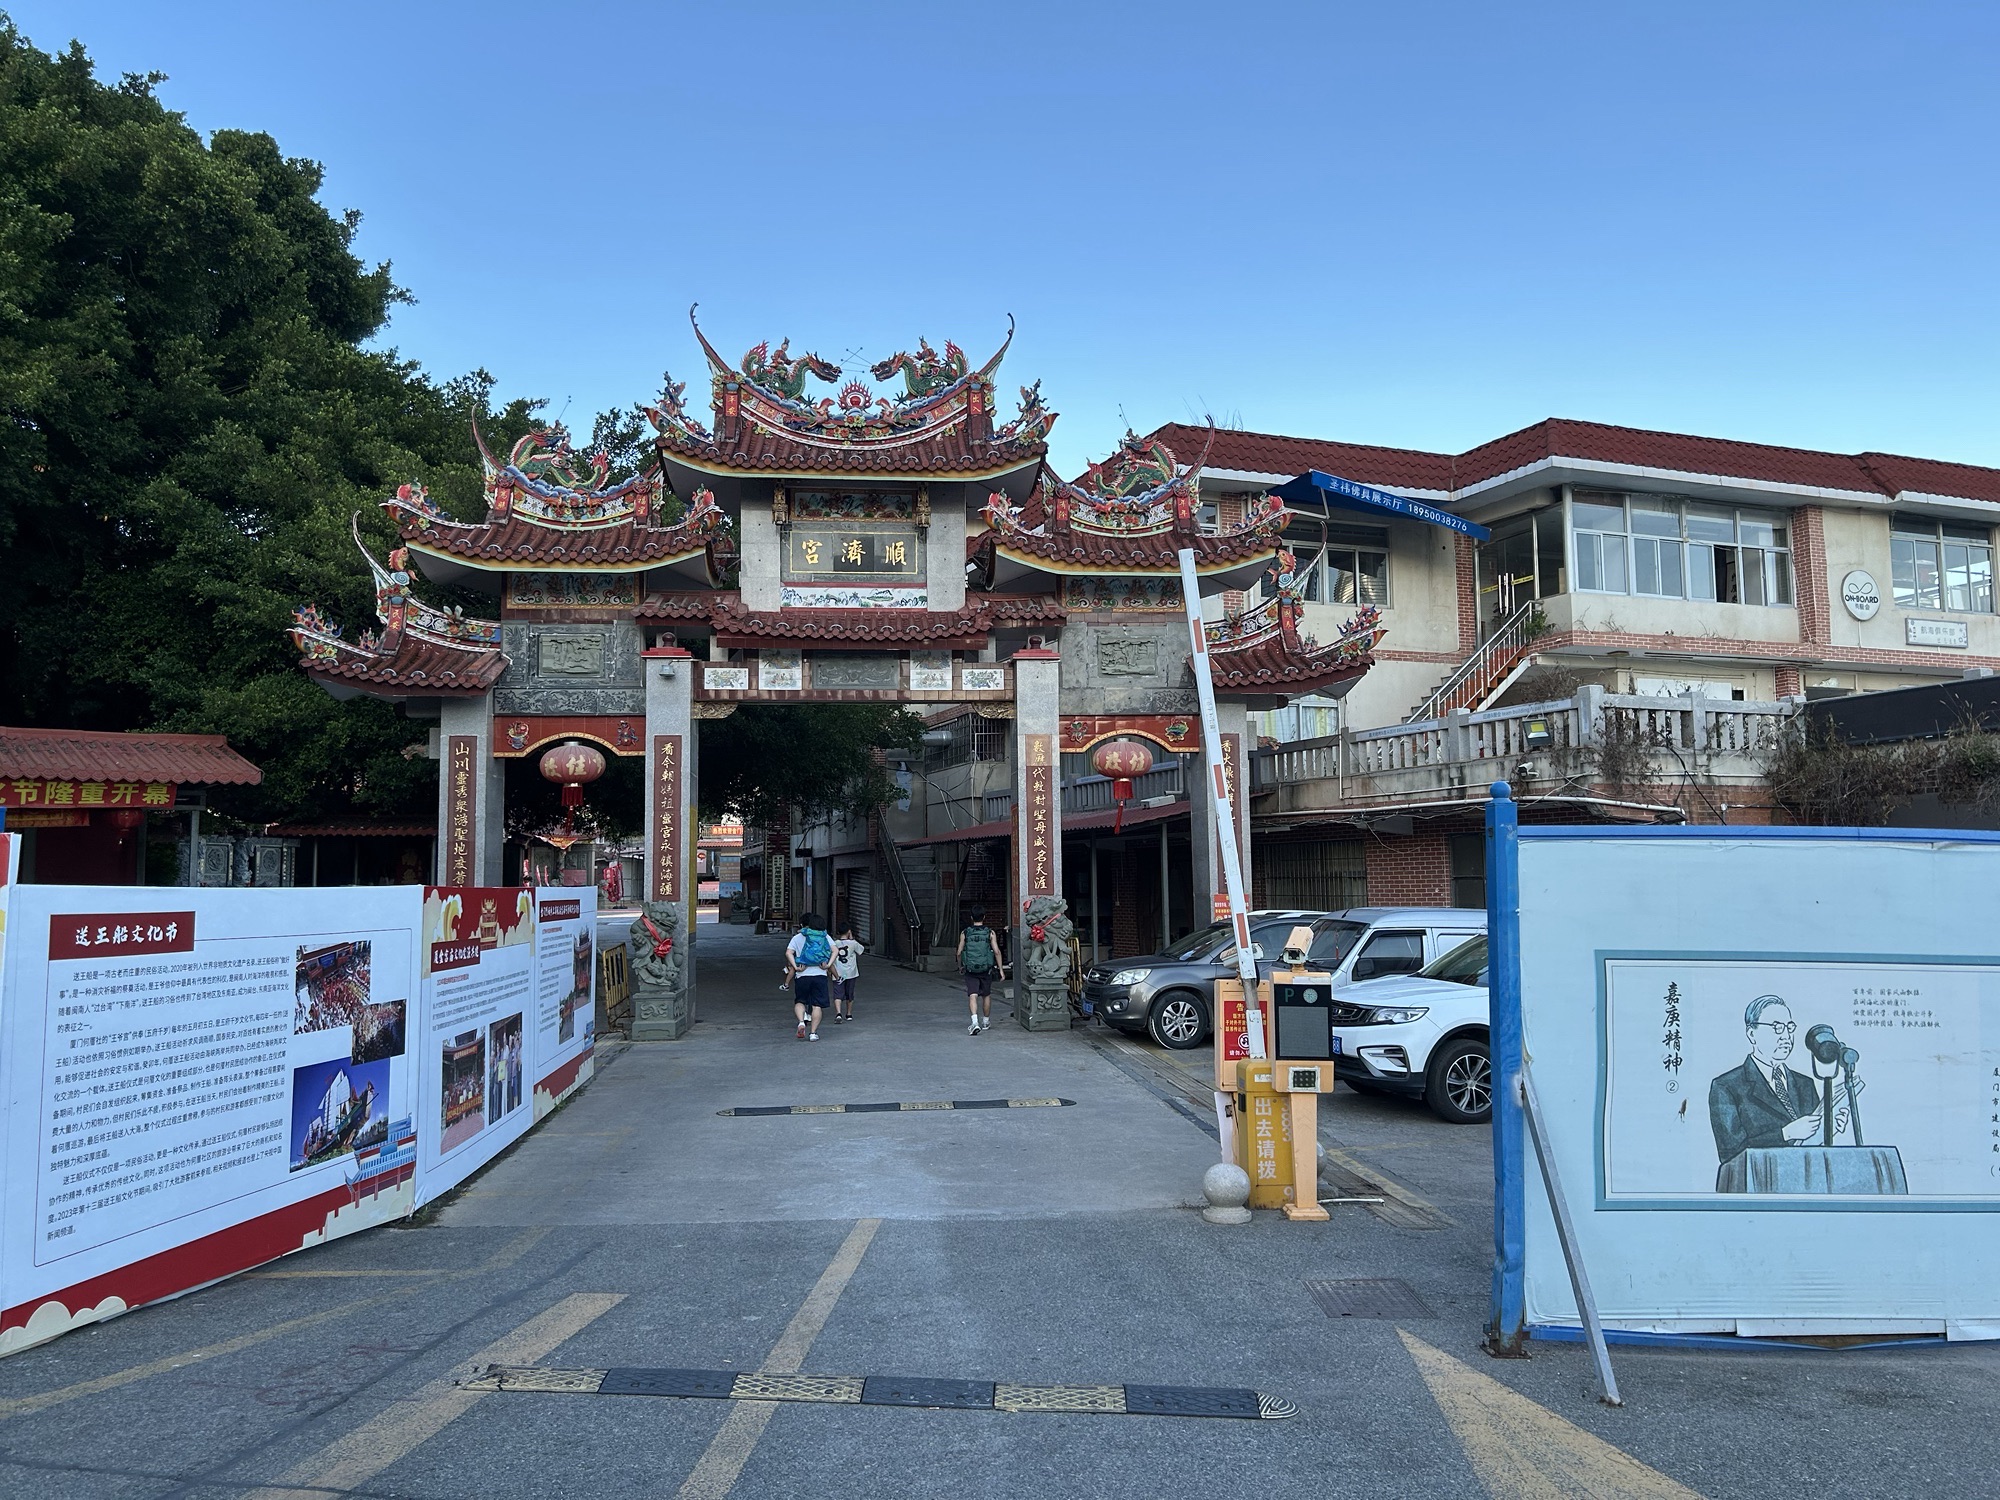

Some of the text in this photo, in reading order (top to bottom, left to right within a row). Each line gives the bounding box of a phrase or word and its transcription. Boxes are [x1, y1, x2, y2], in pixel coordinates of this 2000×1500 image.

[971, 393, 983, 414] 出入
[1408, 502, 1468, 533] 18950038276
[801, 539, 907, 567] 順濟宮
[1844, 594, 1879, 604] ON-BOARD
[75, 922, 178, 947] 送王船文化节
[1284, 988, 1295, 1002] P
[57, 1020, 92, 1034] 的表征之一。
[1255, 1097, 1276, 1179] 出去请拨
[46, 1224, 76, 1243] 新闻频道。
